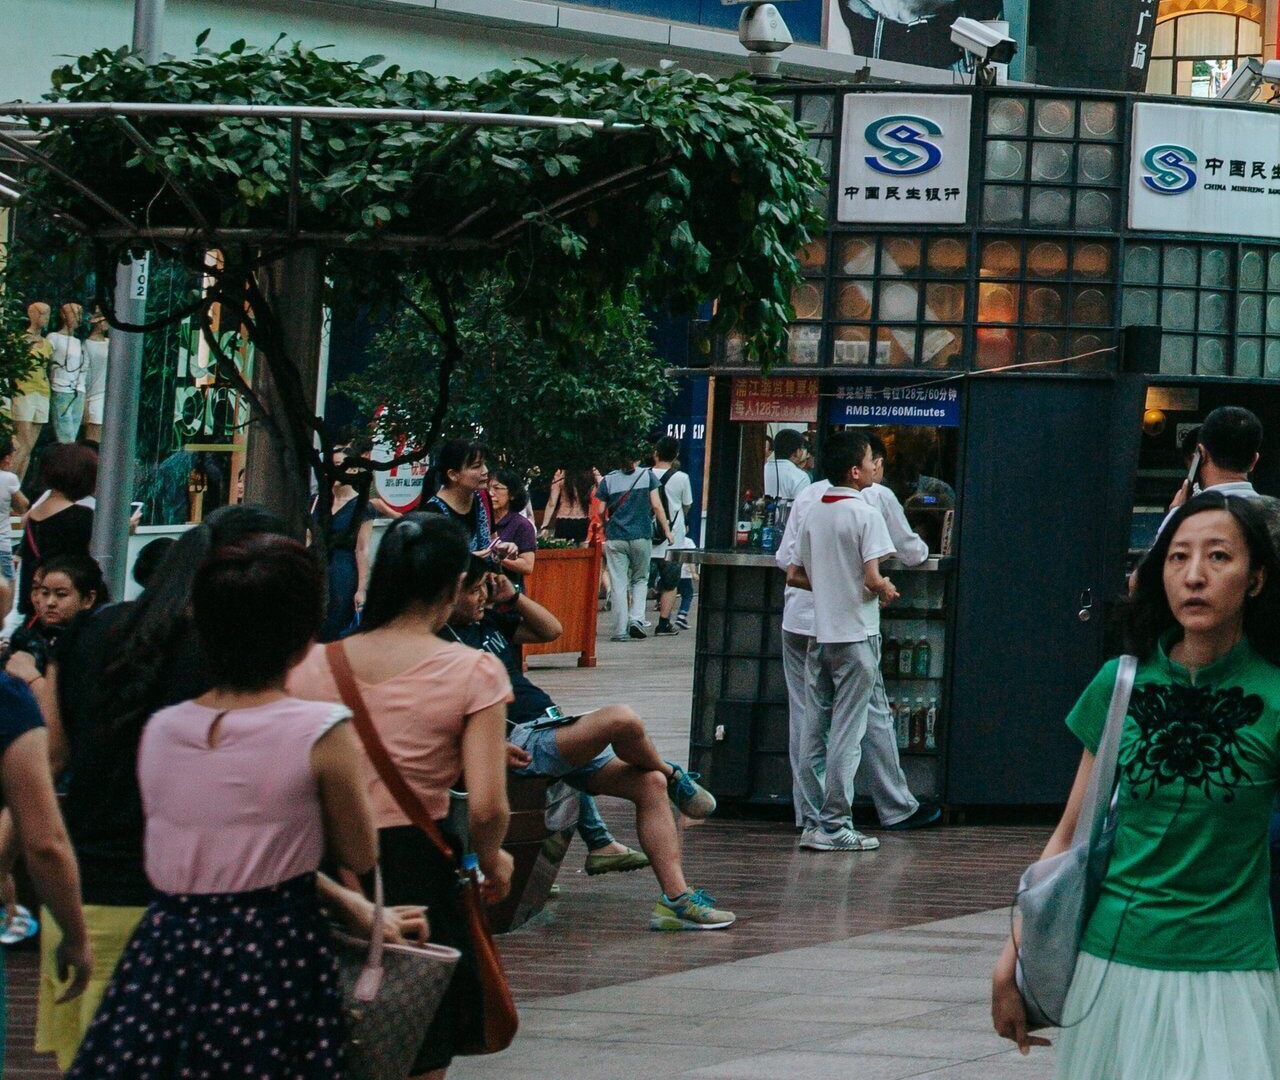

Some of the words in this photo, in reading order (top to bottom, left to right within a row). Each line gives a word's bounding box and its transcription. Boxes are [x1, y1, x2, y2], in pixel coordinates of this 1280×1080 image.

[1204, 183, 1227, 191] CHINA
[844, 186, 960, 201] 中国民生银行
[845, 405, 946, 417] RMB128/60Minutes
